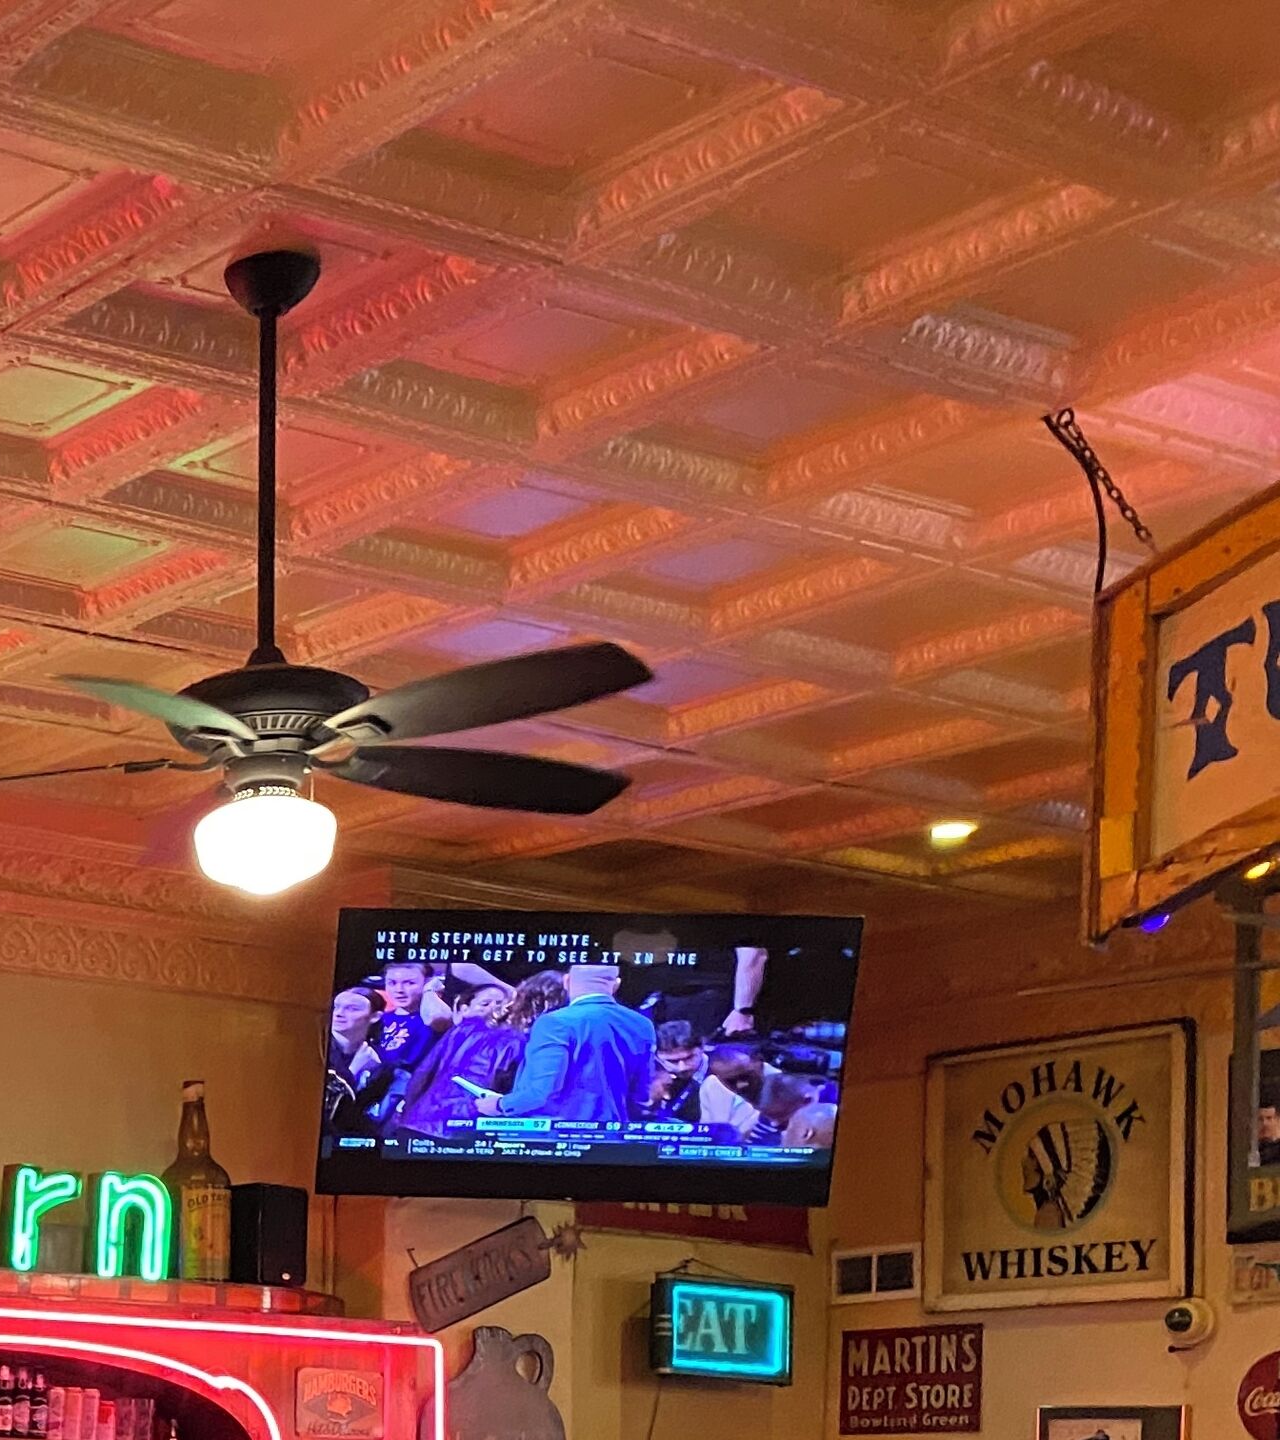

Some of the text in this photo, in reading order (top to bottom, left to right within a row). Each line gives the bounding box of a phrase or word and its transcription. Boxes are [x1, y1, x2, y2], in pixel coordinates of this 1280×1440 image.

[1168, 600, 1280, 783] T
[376, 948, 697, 965] WE DIDN'T GET TO SEE IT IN THE
[377, 931, 600, 948] WITH STEPHANIE WHITE.
[971, 1059, 1146, 1155] MOHAWK
[653, 1124, 685, 1133] 4:47
[1249, 1177, 1280, 1212] B
[962, 1239, 1158, 1282] WHISKEY
[674, 1298, 758, 1355] EAT
[847, 1333, 978, 1377] MARTINS
[303, 1372, 377, 1409] HAMBURGERS
[847, 1382, 974, 1412] DEPT STORE
[849, 1413, 970, 1428] Bowling Green
